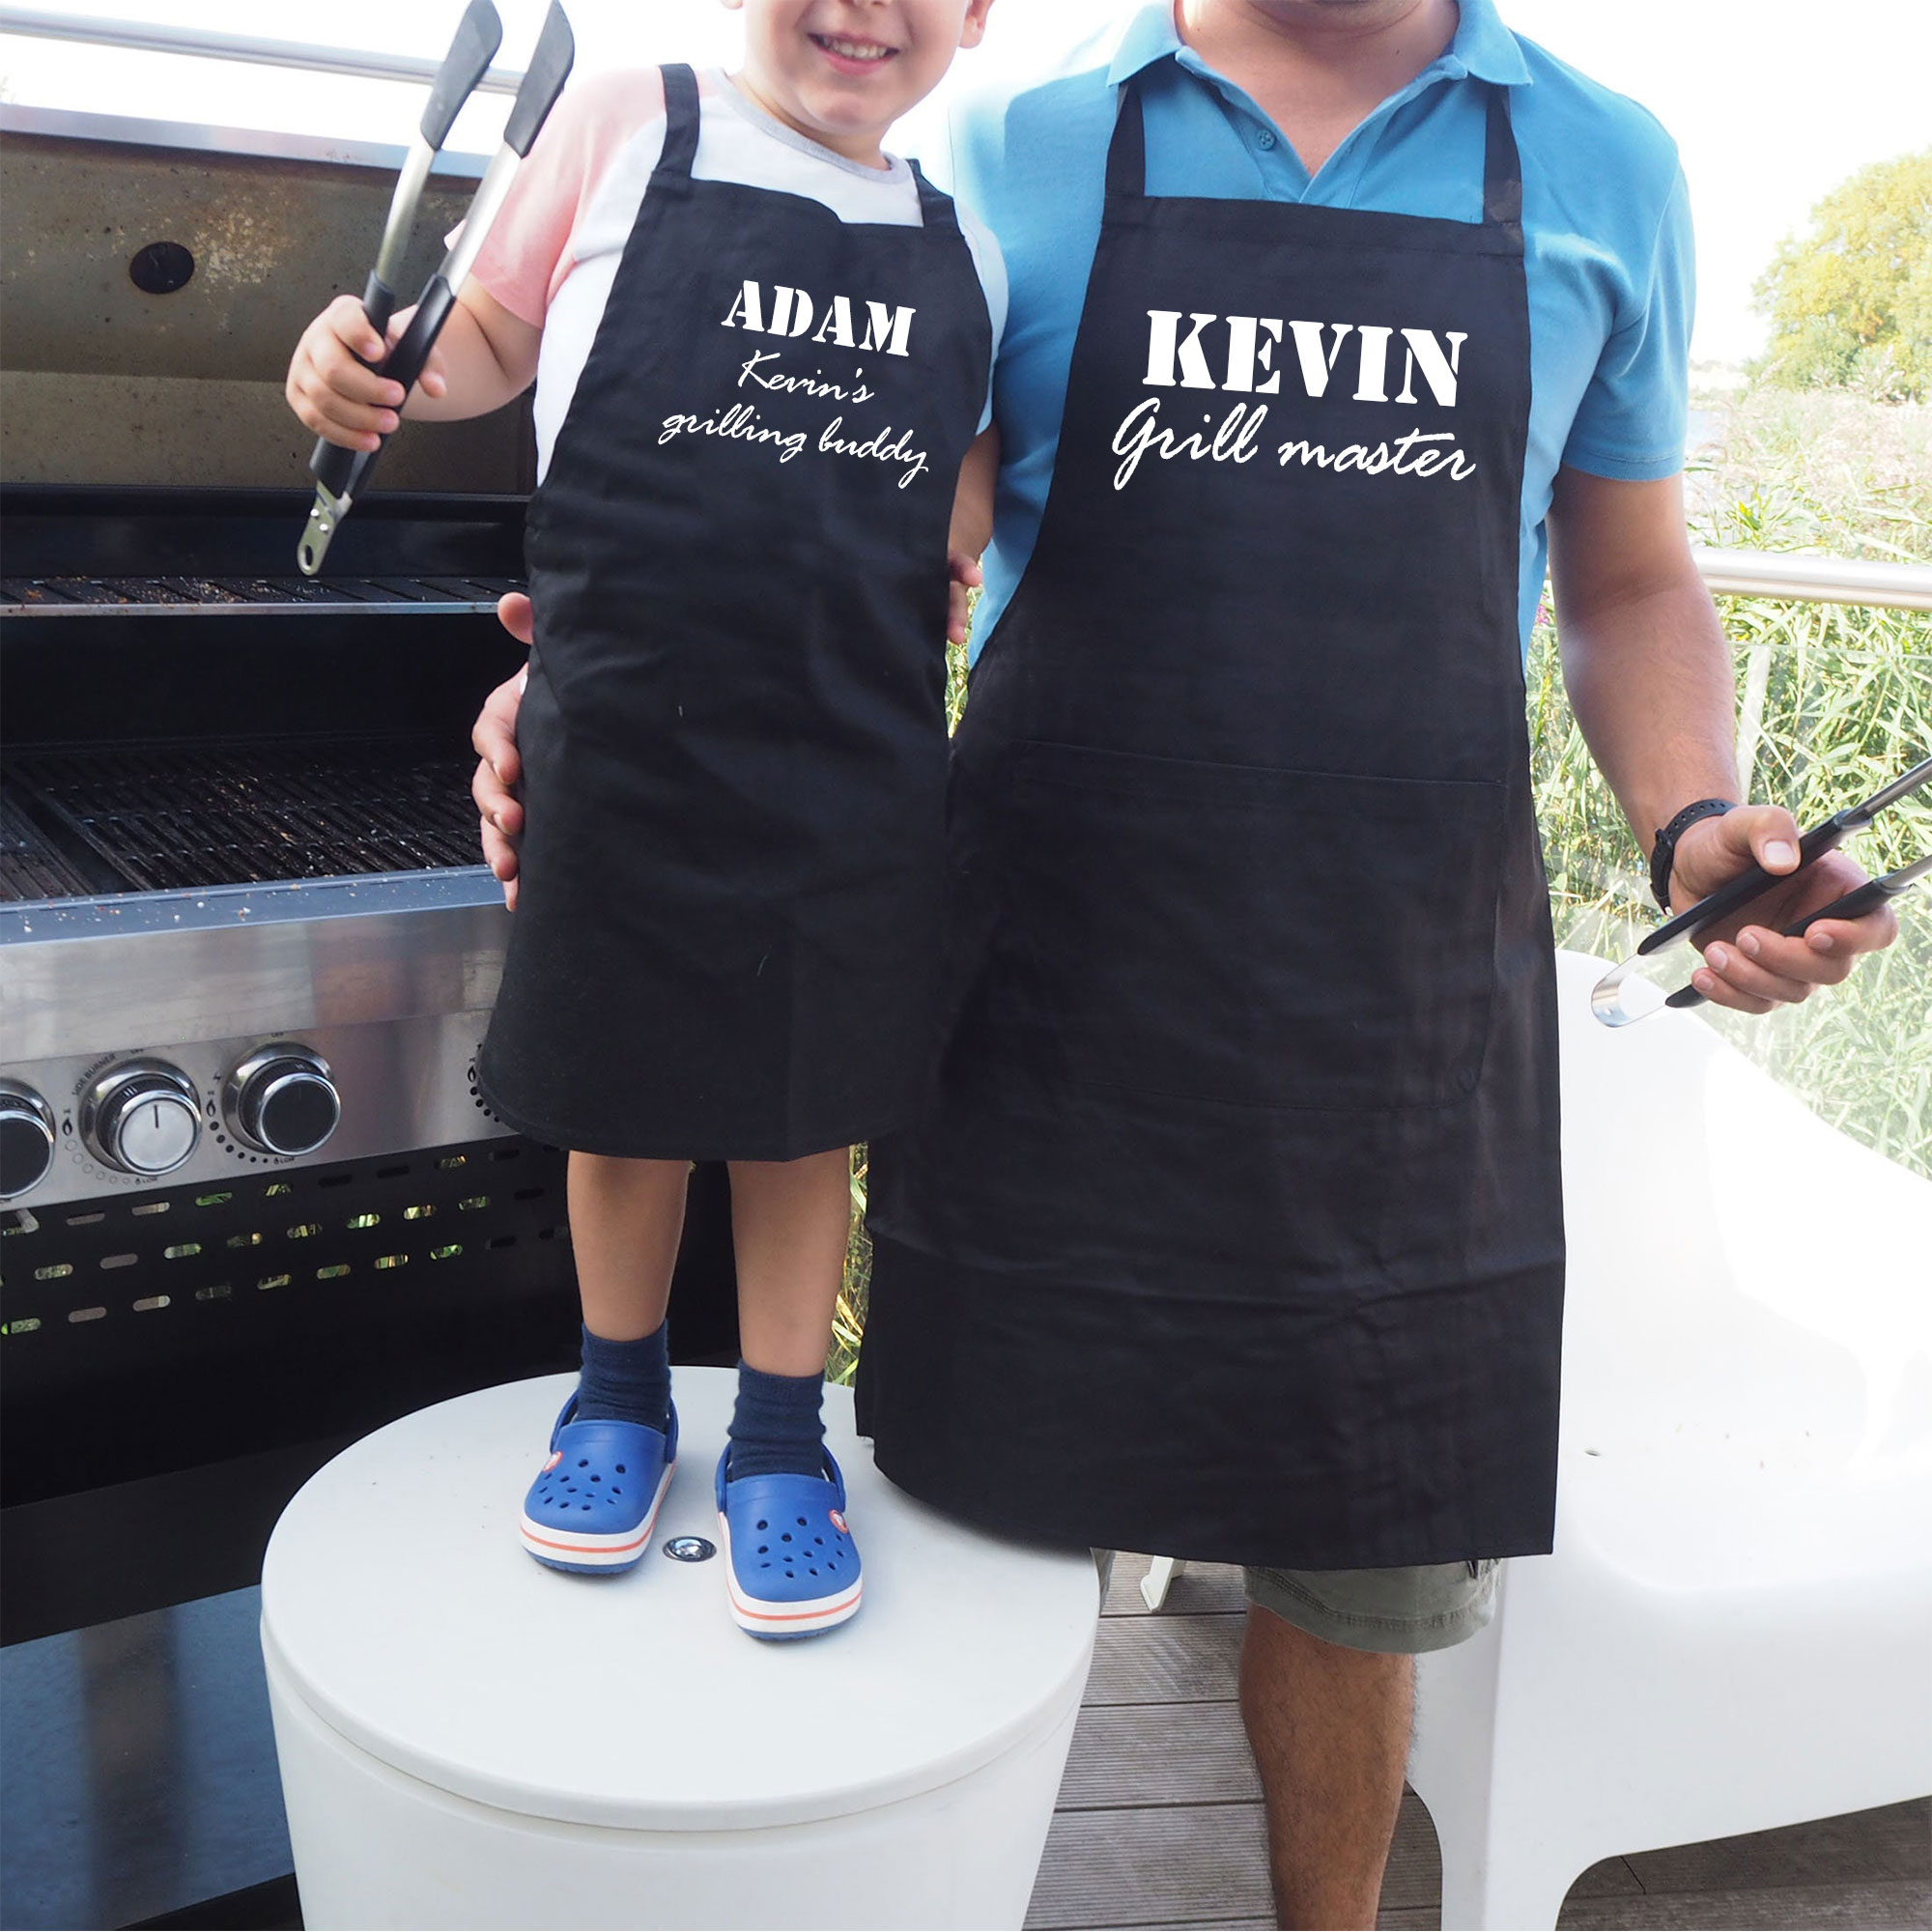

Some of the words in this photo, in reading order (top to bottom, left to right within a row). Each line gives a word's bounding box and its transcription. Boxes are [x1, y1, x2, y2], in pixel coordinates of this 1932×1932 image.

[720, 279, 917, 357] ADAM
[1142, 309, 1468, 408] KEVIN
[737, 349, 875, 404] Kevin's
[657, 403, 808, 464] grilling
[818, 415, 929, 490] buddy
[1111, 397, 1269, 491] Grill
[1277, 427, 1477, 481] master
